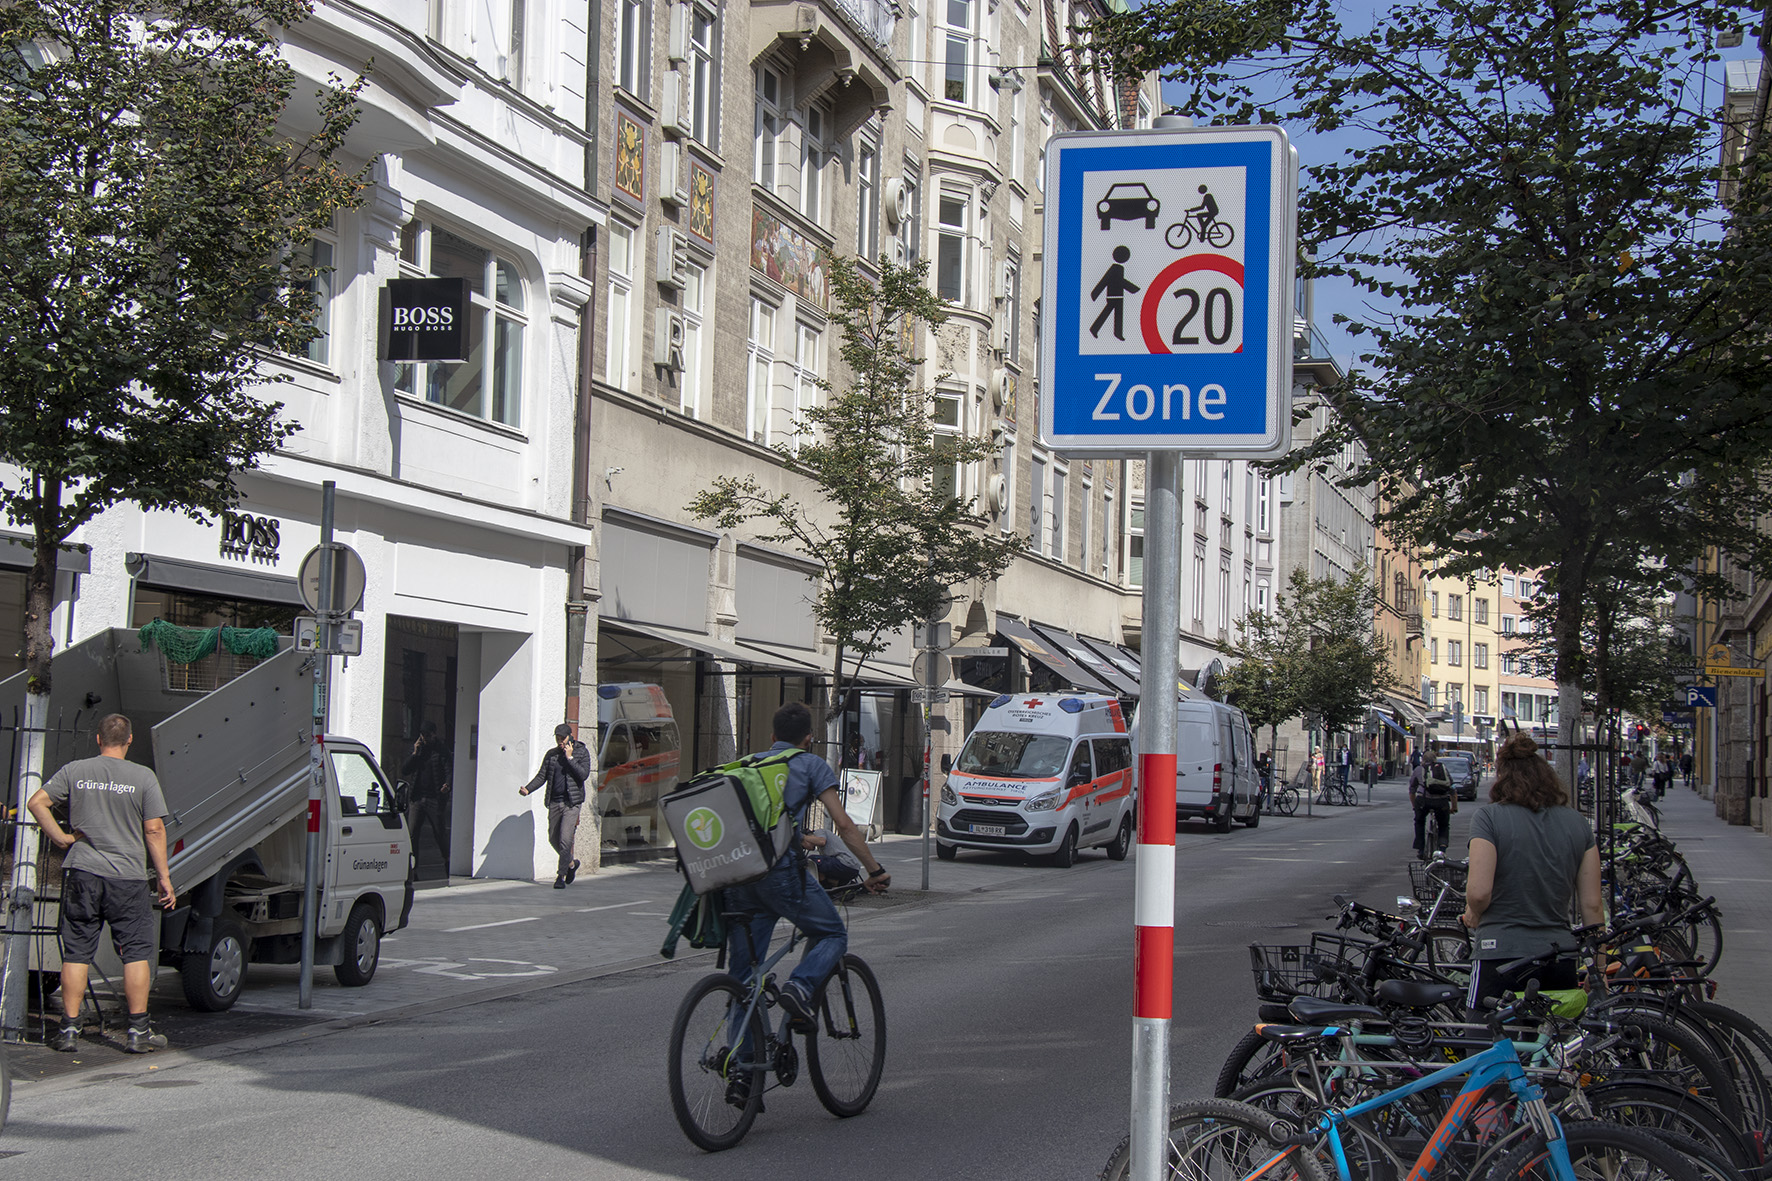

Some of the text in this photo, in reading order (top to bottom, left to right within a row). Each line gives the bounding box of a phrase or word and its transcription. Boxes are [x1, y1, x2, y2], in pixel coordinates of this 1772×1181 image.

[393, 306, 454, 325] BOSS
[1172, 287, 1234, 345] 20
[1091, 372, 1228, 421] Zone
[221, 510, 280, 549] BOSS
[1710, 668, 1761, 676] Bienenladen
[1687, 692, 1699, 706] P
[76, 779, 136, 794] Grünanlagen
[964, 781, 1028, 791] AMBULANCE
[352, 858, 388, 873] Grünanlagen
[686, 841, 752, 878] mjam.at
